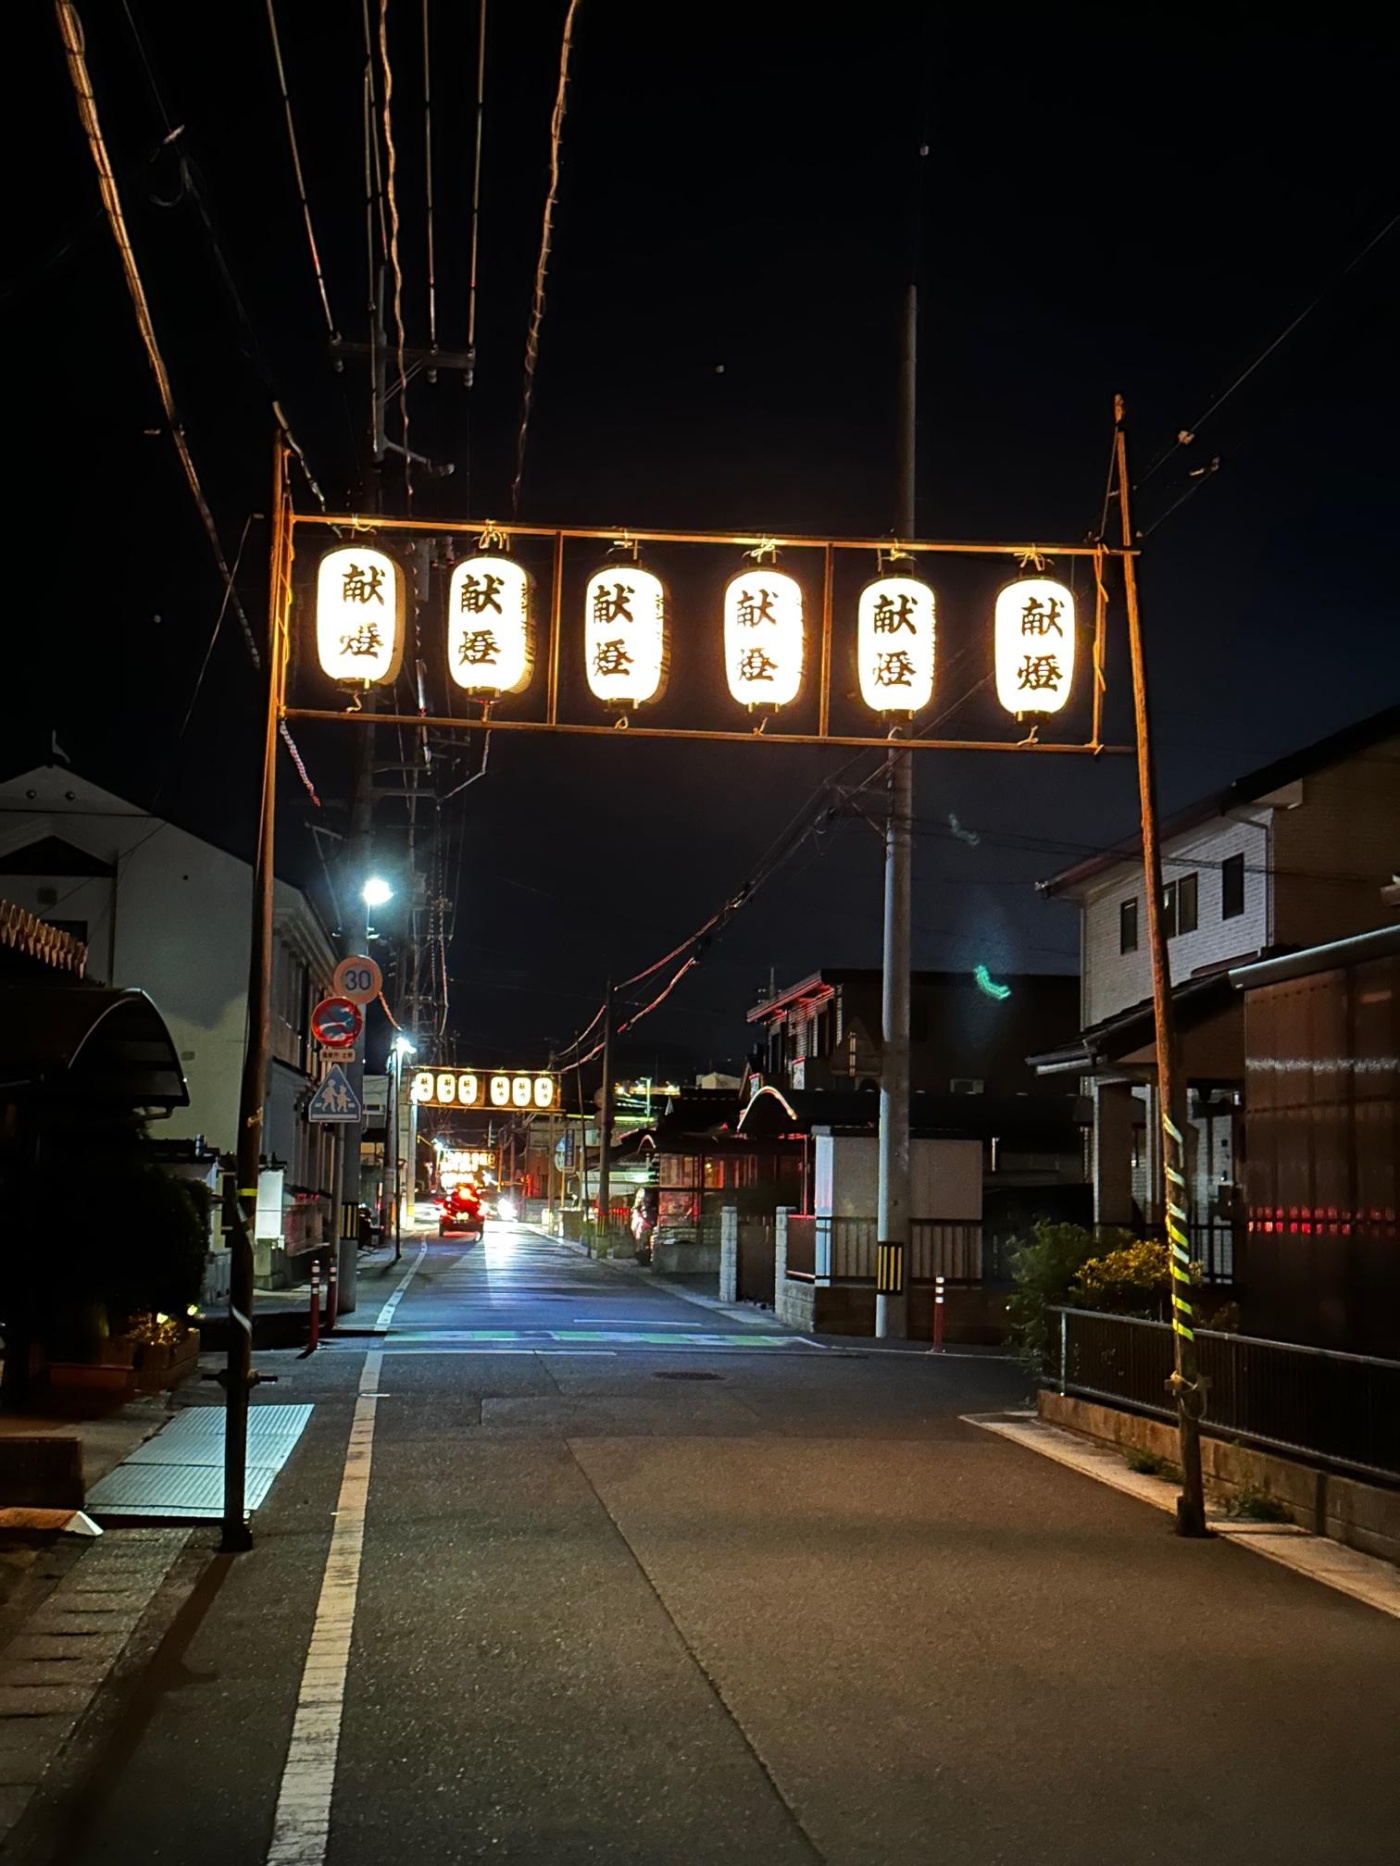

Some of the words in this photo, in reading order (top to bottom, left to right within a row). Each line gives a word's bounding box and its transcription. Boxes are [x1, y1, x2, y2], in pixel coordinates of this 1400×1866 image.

[340, 563, 385, 658] 献燈
[459, 574, 505, 665] 献燈
[593, 584, 635, 676] 献燈
[737, 589, 778, 681] 献燈
[873, 594, 918, 687] 献燈
[1017, 597, 1063, 692] 献燈
[345, 969, 371, 991] 30
